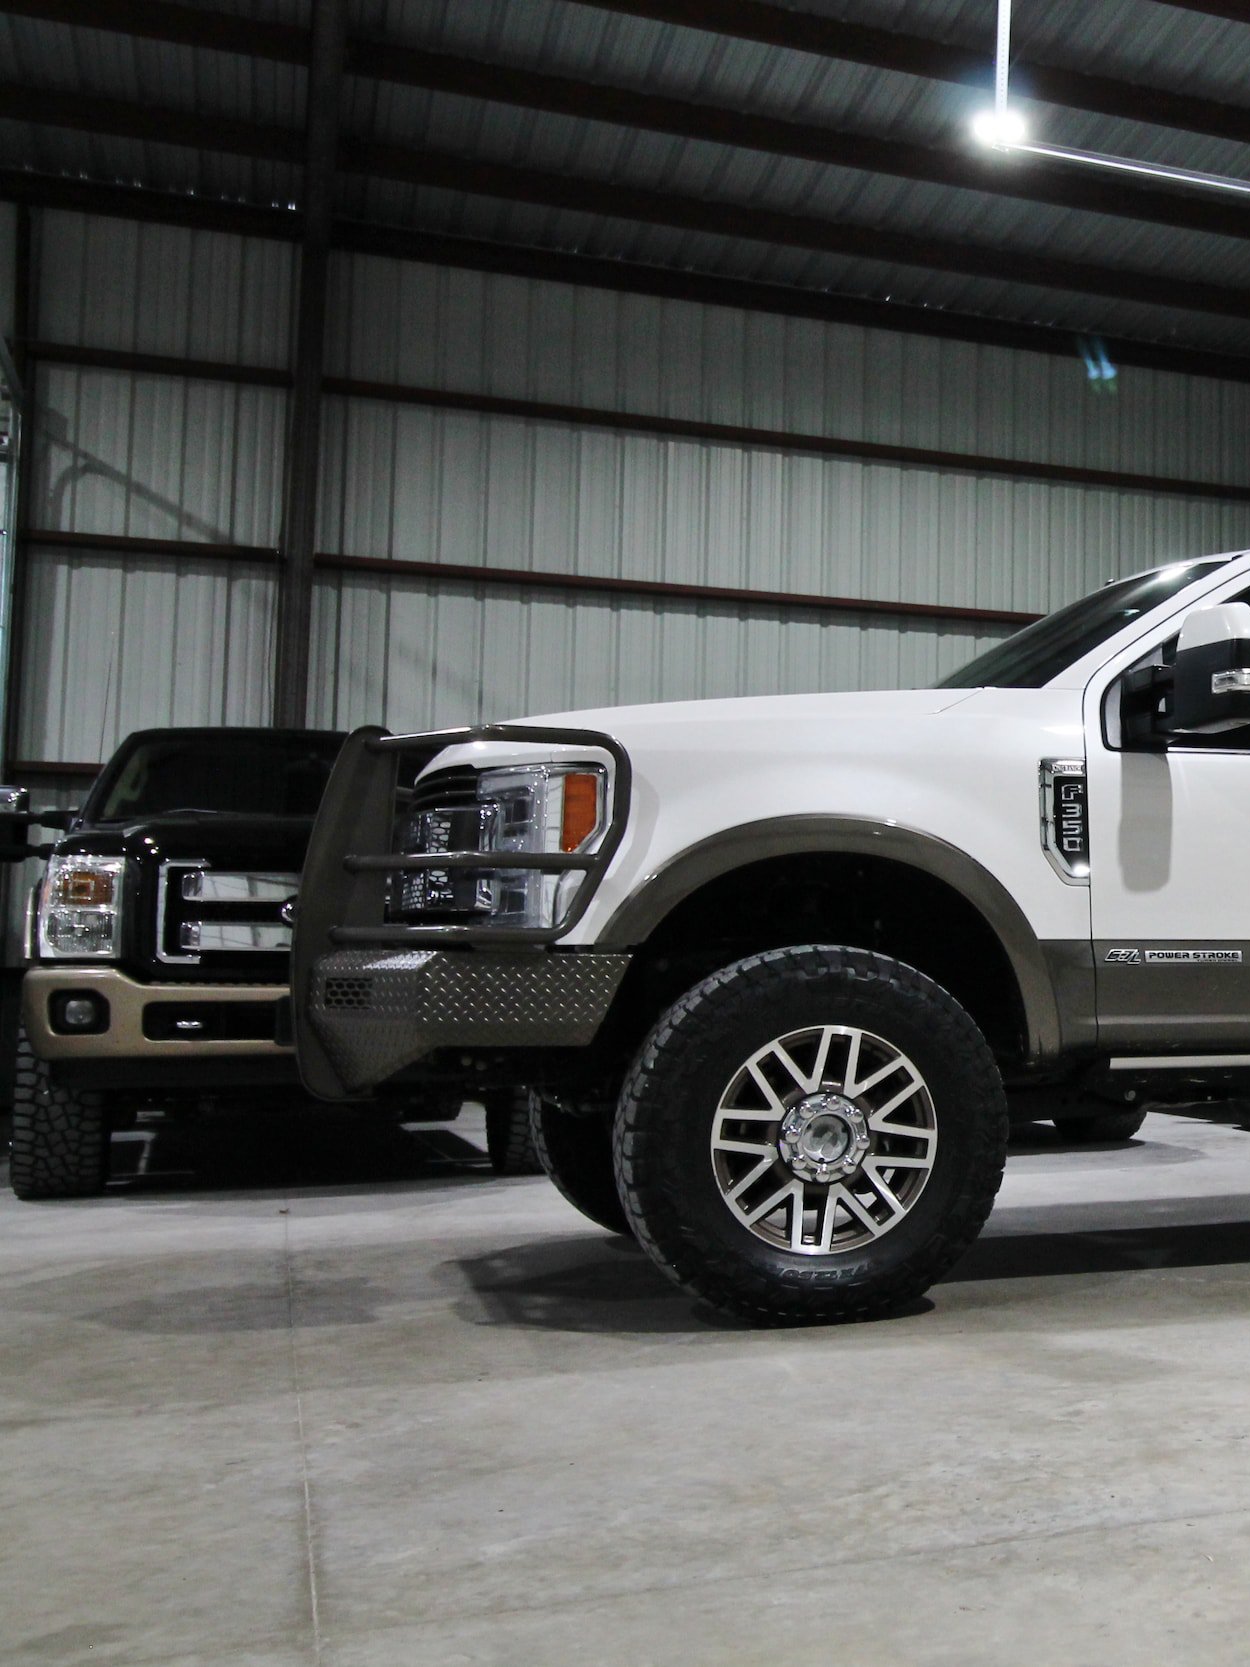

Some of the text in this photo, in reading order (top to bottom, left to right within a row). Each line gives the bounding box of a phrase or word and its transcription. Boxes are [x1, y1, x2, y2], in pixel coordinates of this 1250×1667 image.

[1061, 784, 1083, 851] F350
[1149, 951, 1190, 959] POWER
[1192, 951, 1239, 959] STROKE
